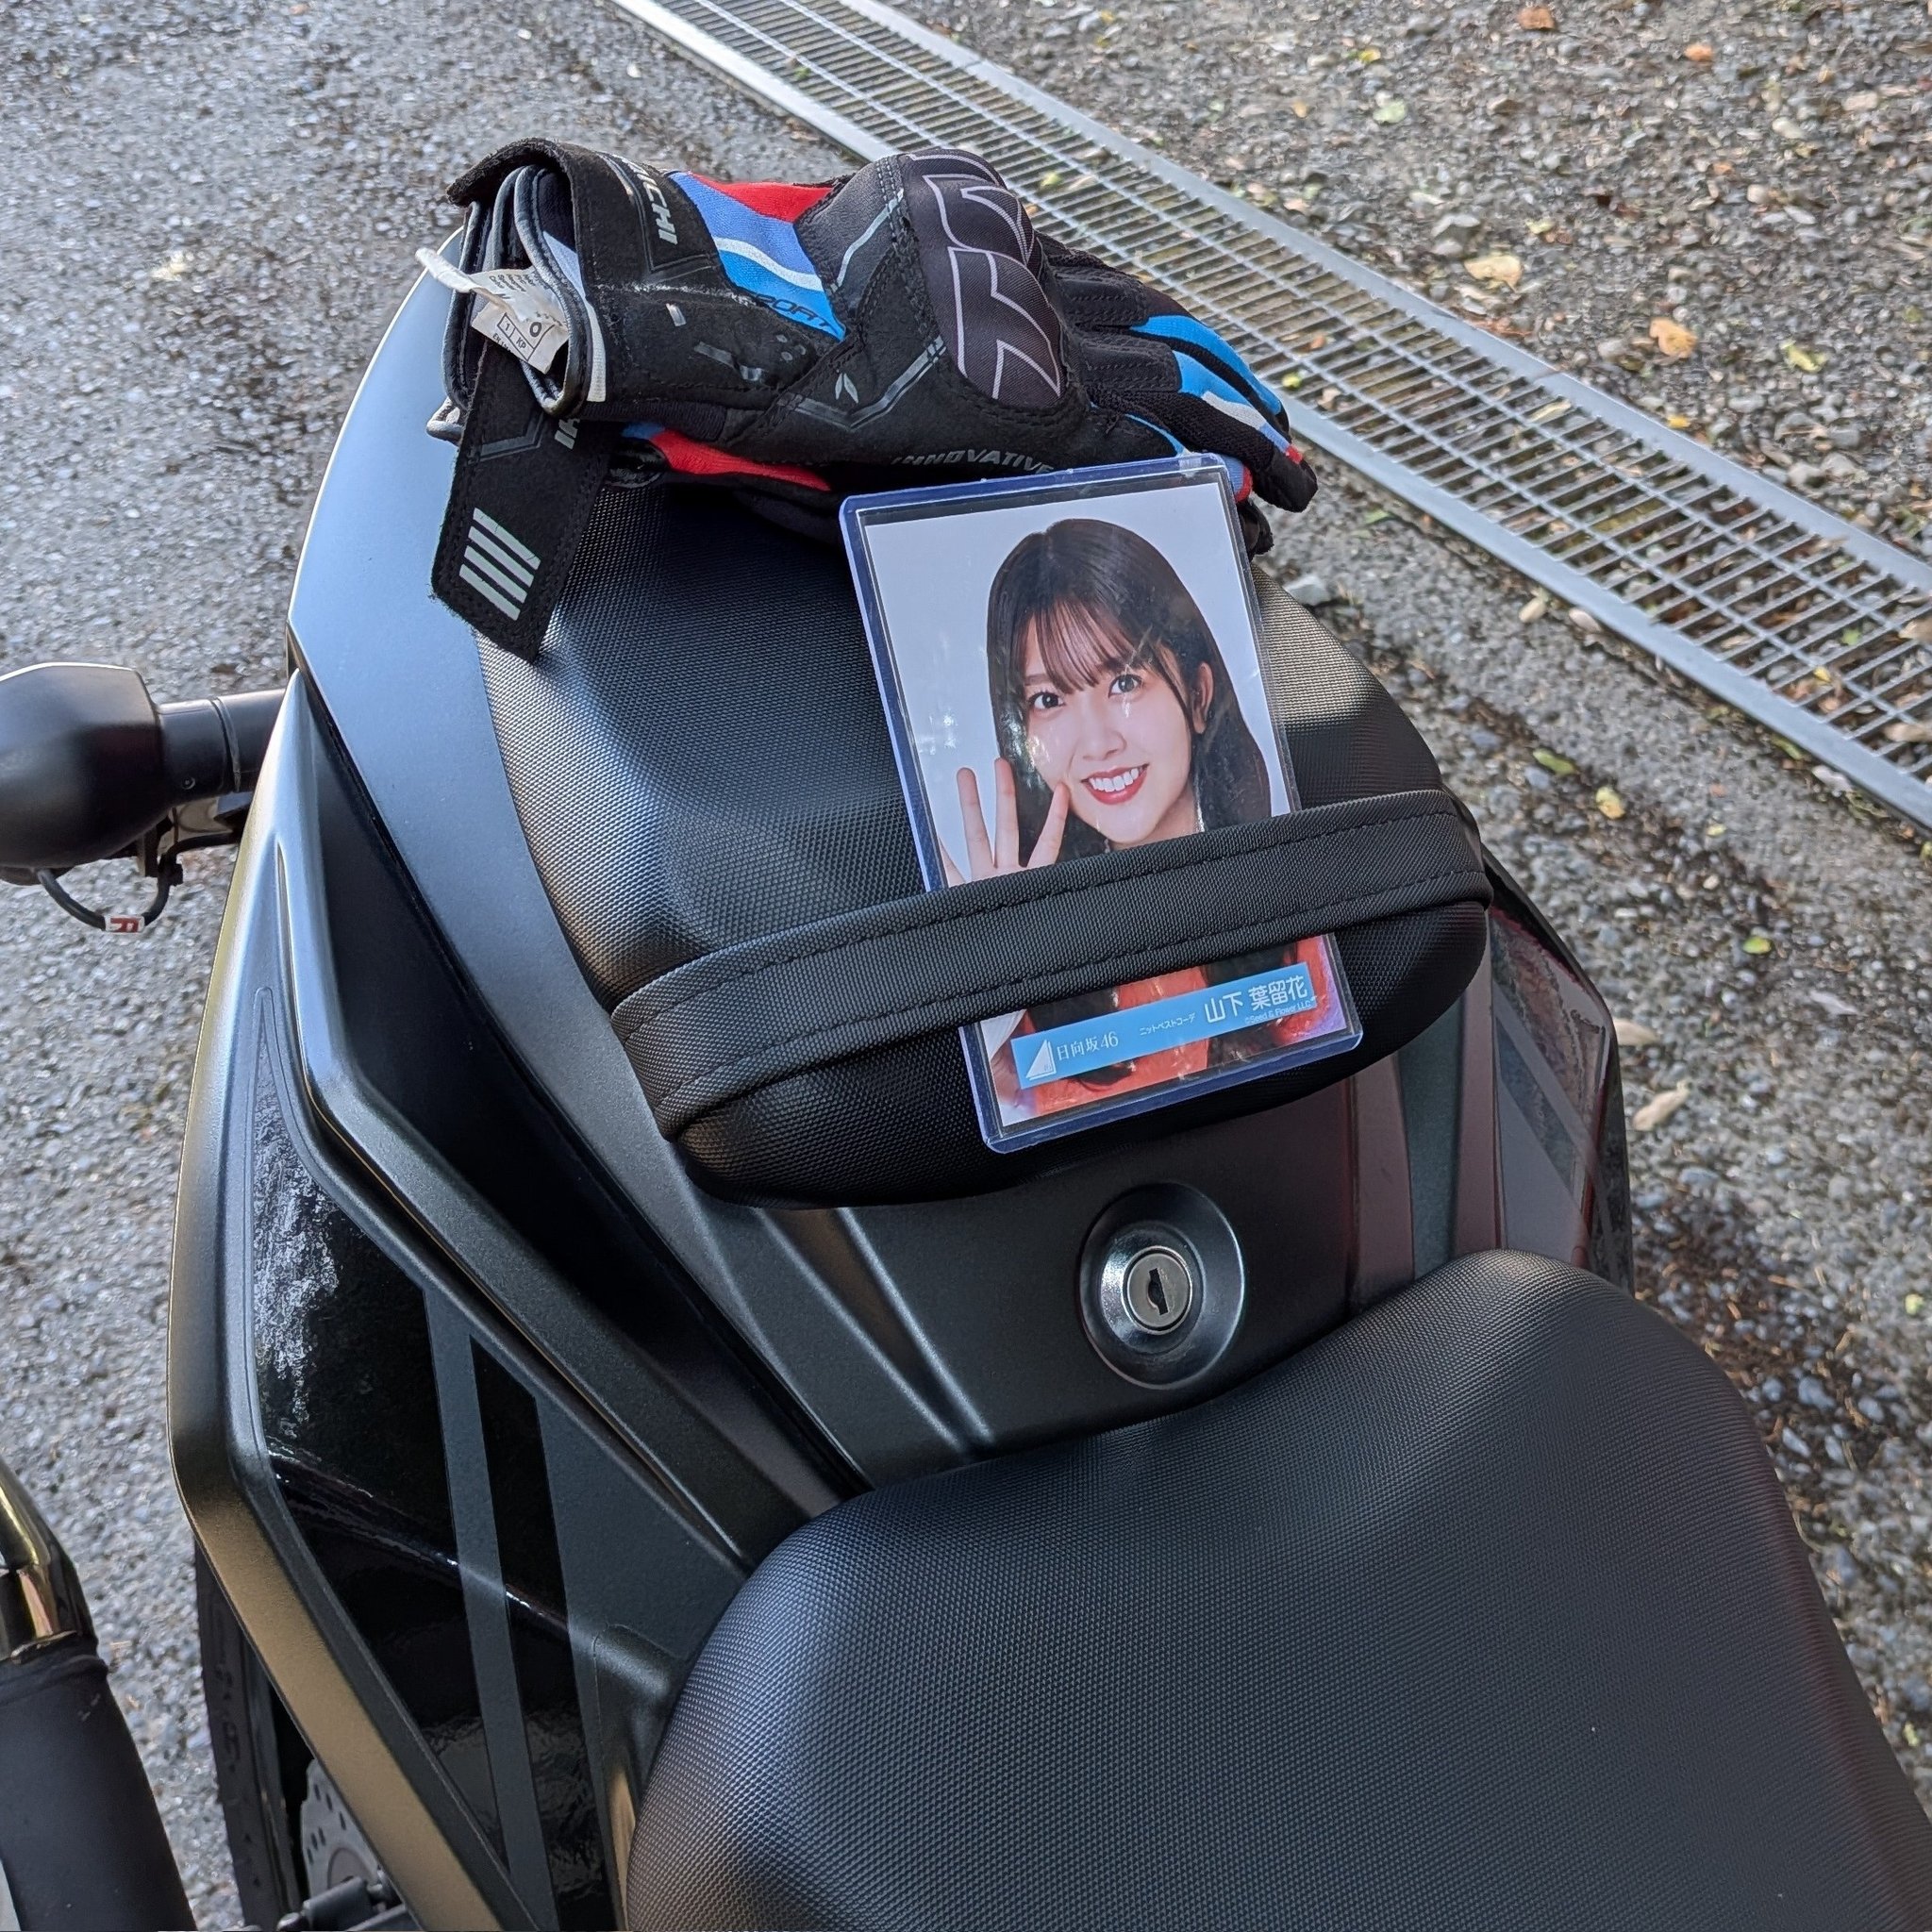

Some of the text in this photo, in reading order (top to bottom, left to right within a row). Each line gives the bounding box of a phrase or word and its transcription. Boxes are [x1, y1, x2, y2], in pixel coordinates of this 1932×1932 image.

[1204, 974, 1308, 1024] 山下 葉留花
[1056, 1030, 1120, 1061] 日向坂46
